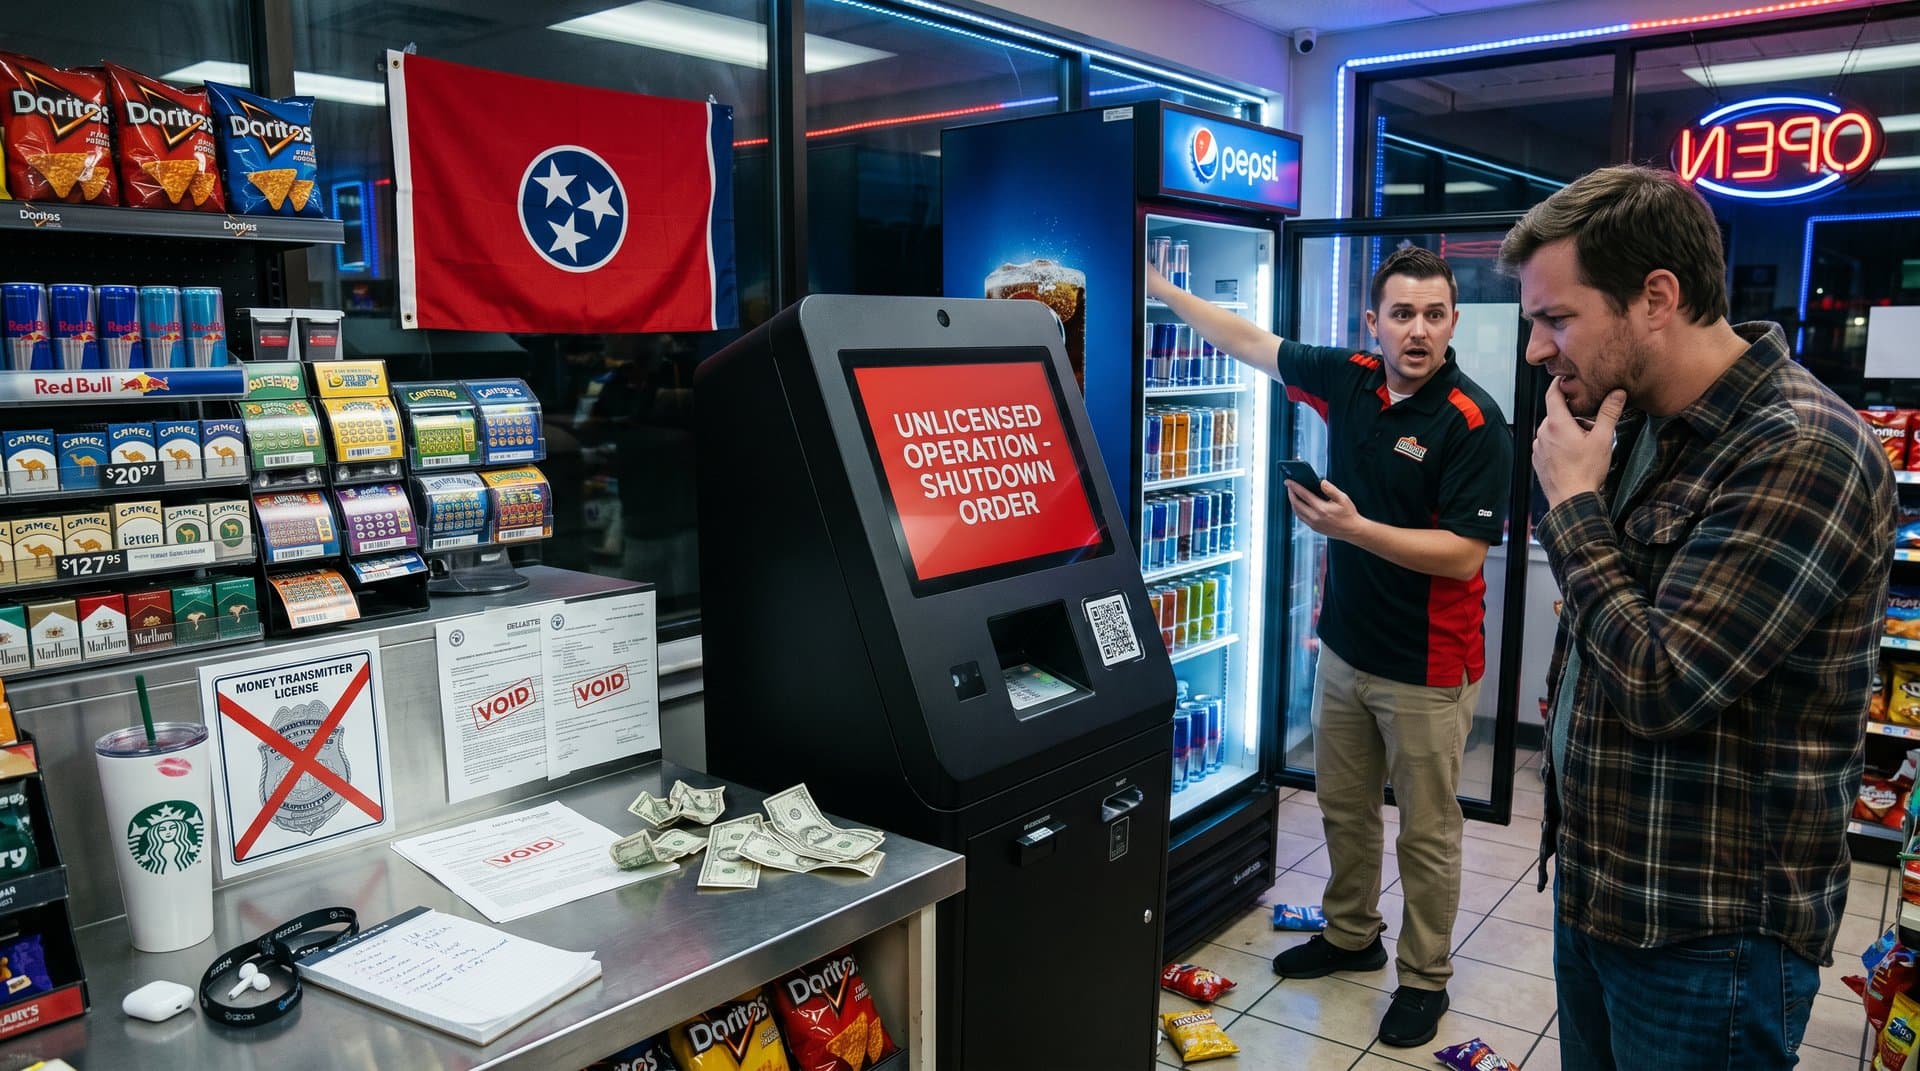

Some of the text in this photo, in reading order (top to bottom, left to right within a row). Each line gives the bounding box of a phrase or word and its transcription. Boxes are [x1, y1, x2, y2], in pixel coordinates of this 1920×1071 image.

[13, 90, 110, 124] Doritos
[127, 102, 213, 134] Doritos
[230, 115, 313, 143] Doritos
[8, 320, 32, 331] Red
[59, 320, 83, 331] Red
[108, 321, 131, 332] Red
[35, 376, 112, 394] Red Bull
[893, 404, 1042, 438] UNLICENSED
[113, 428, 152, 439] CAMEL
[160, 426, 197, 437] CAMEL
[205, 424, 241, 436] CAMEL
[8, 434, 52, 447] CAMEL
[62, 437, 105, 449] CAMEL
[903, 432, 1039, 469] OPERATION
[920, 459, 1056, 499] SHUTDOWN
[120, 506, 159, 517] CAMEL
[168, 509, 205, 521] CAMEL
[212, 504, 248, 516] CAMEL
[959, 491, 1040, 525] ORDER
[15, 522, 60, 535] CAMEL
[67, 517, 108, 530] CAMEL
[135, 629, 173, 645] Marlboro
[236, 663, 353, 694] MONEY TRANSMITTER
[573, 672, 625, 702] VOID
[274, 682, 319, 699] LICENSE
[477, 686, 530, 721] VOID
[493, 839, 554, 863] VOID
[788, 956, 858, 1005] Dorito
[689, 994, 768, 1051] Doritos
